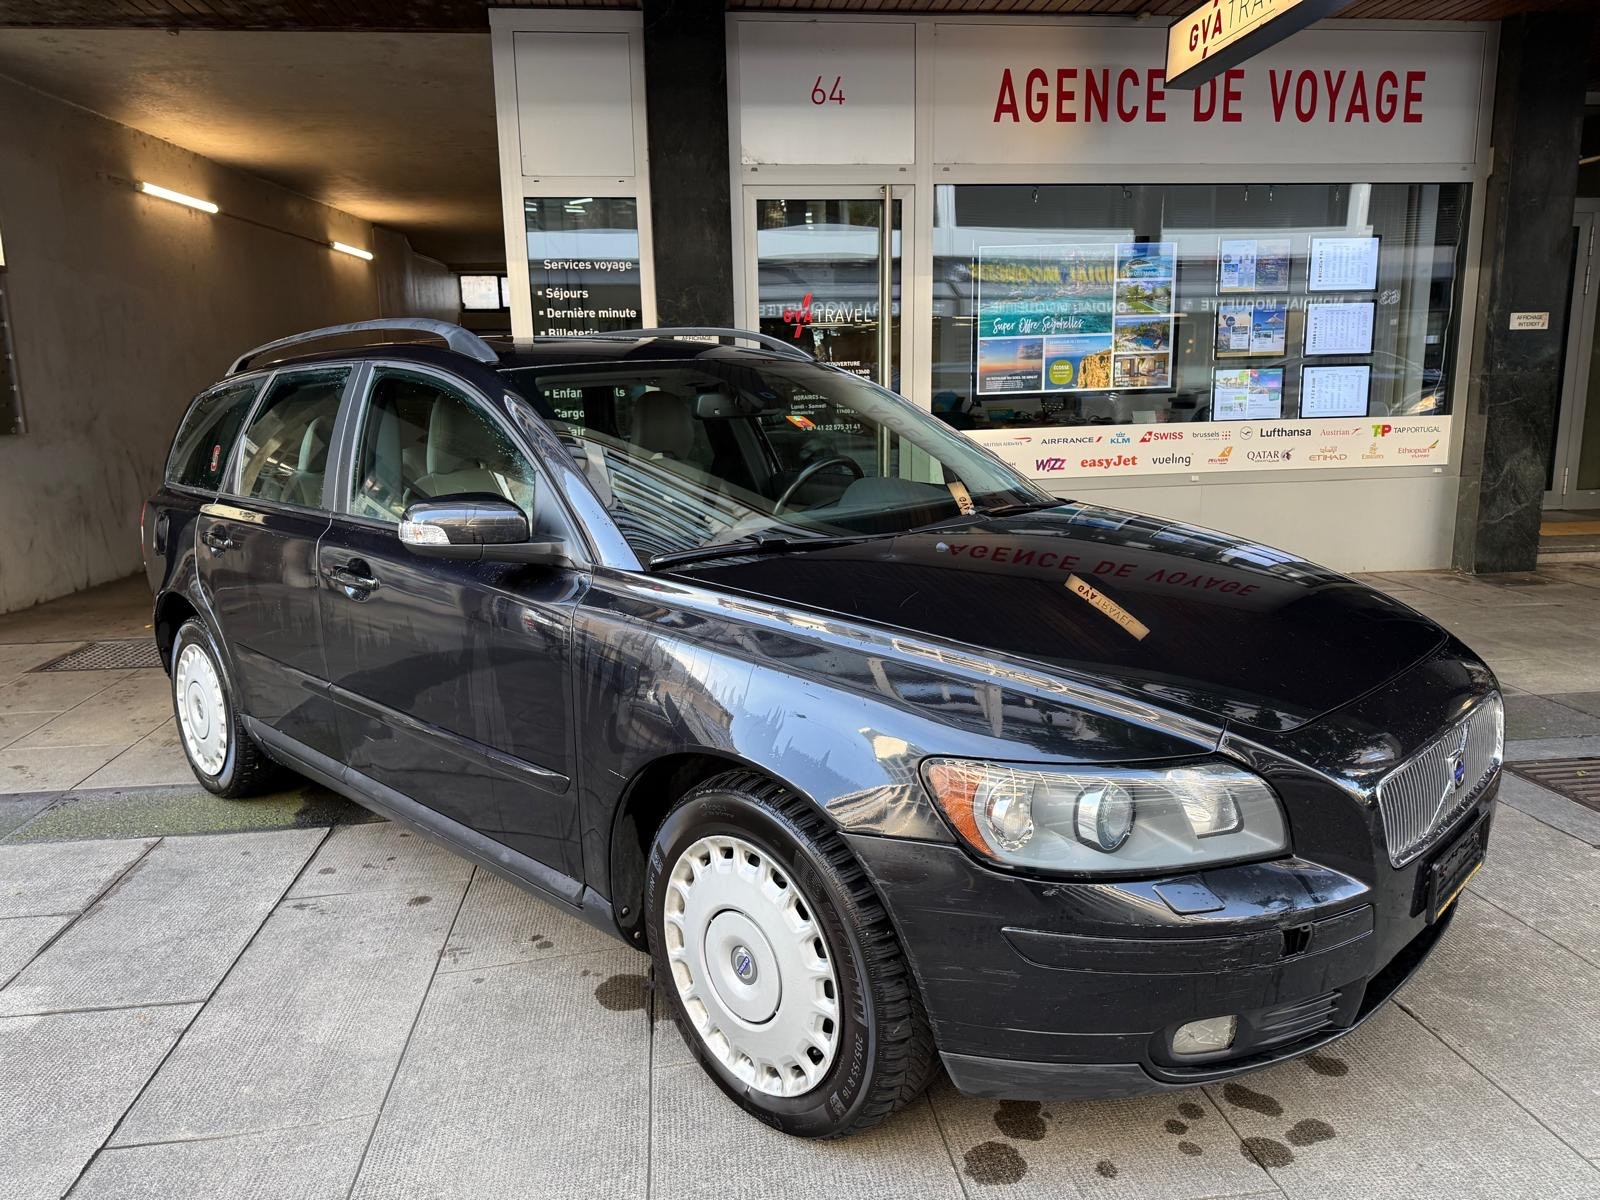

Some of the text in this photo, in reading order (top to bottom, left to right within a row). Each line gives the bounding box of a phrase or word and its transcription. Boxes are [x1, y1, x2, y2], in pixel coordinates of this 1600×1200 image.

[1189, 0, 1273, 52] GVA TRA
[811, 76, 846, 105] 64
[993, 68, 1427, 124] AGENCE DE VOYAGE
[543, 259, 633, 272] Services voyage
[545, 287, 589, 300] Séjours
[547, 307, 637, 319] Dernière minute
[782, 309, 814, 323] GVA
[815, 308, 873, 323] TRAVEL
[992, 317, 1016, 334] Super
[552, 388, 583, 399] Enfan
[1153, 431, 1184, 441] SWISS
[1192, 431, 1220, 439] brussels
[1260, 427, 1312, 438] Lufthansa
[1320, 428, 1350, 437] Austrian
[1110, 436, 1131, 445] KLM
[1152, 452, 1192, 467] vueling
[1246, 449, 1280, 461] QATAR
[1308, 453, 1348, 462] ETIHAD
[1080, 454, 1138, 470] easyJet
